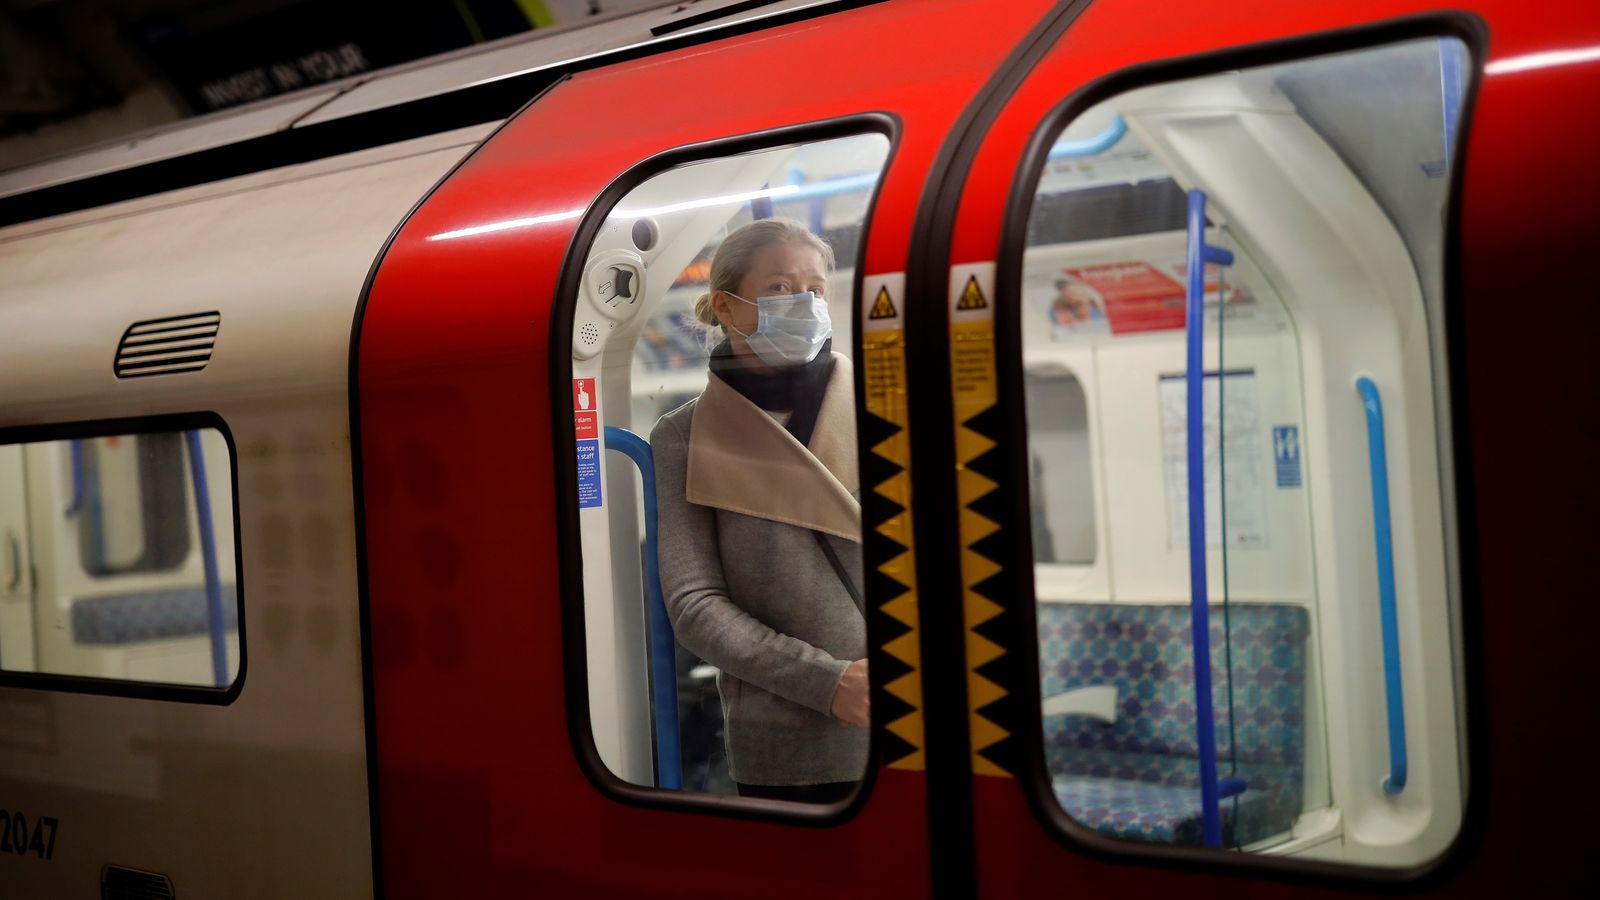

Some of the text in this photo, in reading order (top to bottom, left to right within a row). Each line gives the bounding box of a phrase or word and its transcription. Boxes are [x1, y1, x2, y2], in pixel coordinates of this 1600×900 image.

[200, 42, 369, 108] INVEST IN YOUR
[0, 808, 58, 861] 2047
